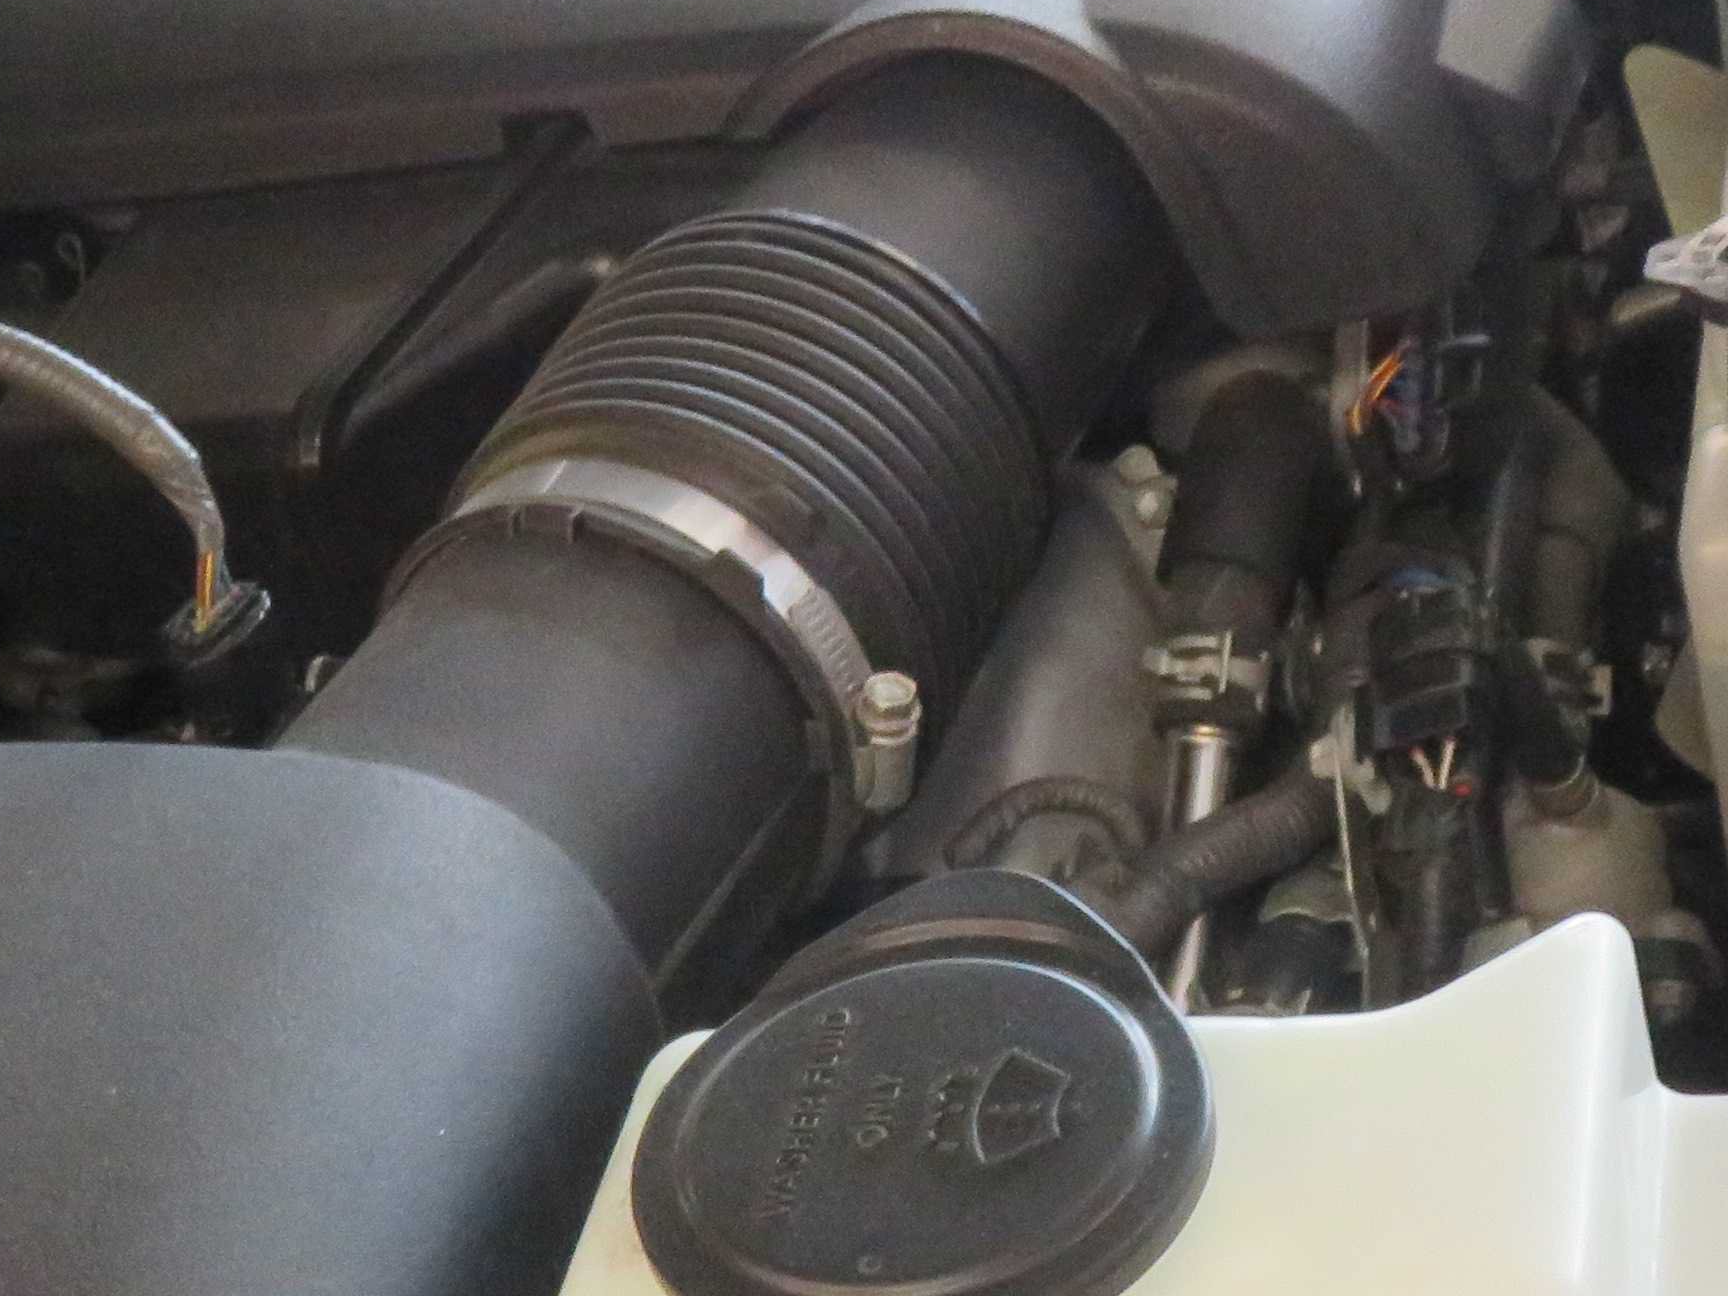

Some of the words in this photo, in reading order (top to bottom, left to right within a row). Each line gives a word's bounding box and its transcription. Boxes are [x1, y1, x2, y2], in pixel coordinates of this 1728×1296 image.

[753, 1095, 828, 1221] WASHER
[802, 1007, 853, 1085] FLUID
[855, 1072, 905, 1150] ONLY
